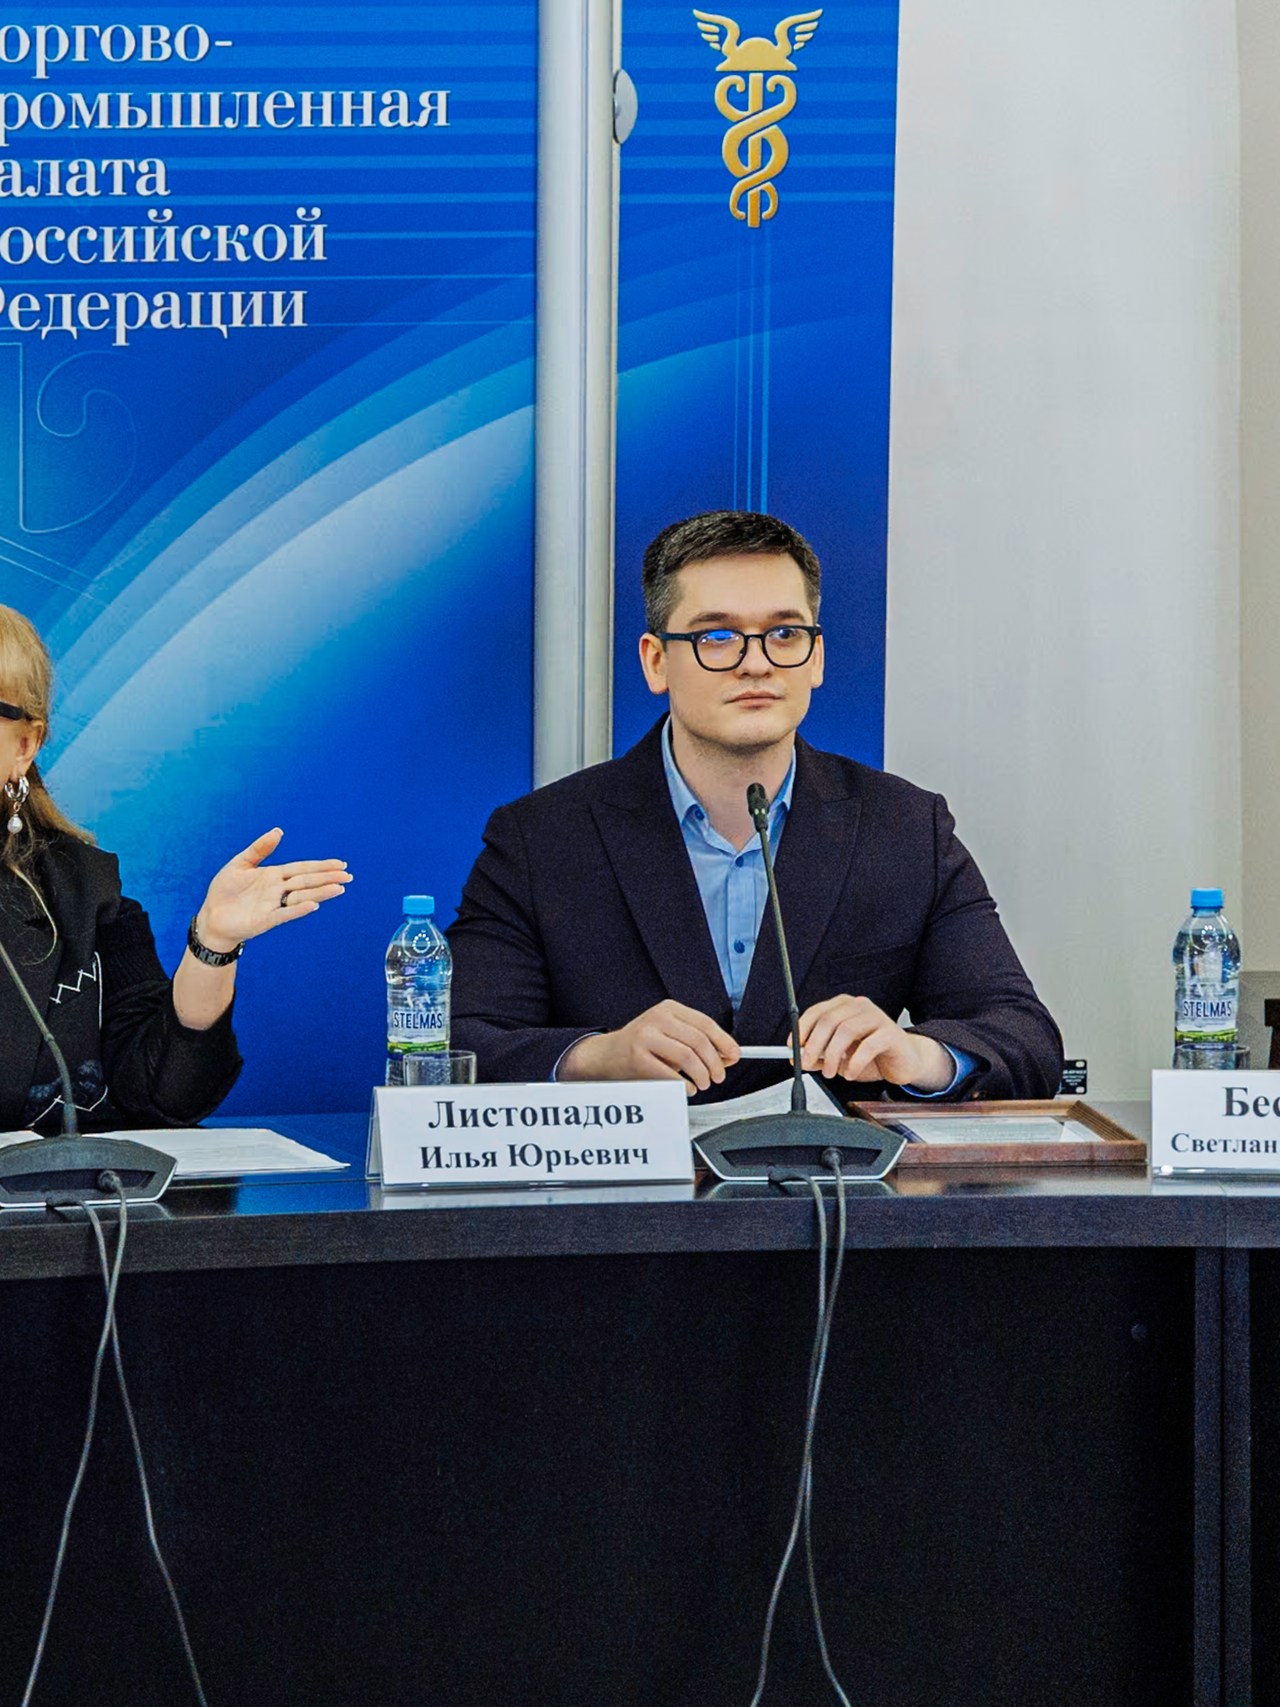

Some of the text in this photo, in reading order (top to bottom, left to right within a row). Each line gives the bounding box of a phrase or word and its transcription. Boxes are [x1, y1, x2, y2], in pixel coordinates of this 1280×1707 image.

[393, 1011, 444, 1030] STELMAS
[1183, 1000, 1233, 1018] STELMAS
[428, 1100, 645, 1130] Листопадов
[418, 1143, 650, 1174] Илья Юрьевич
